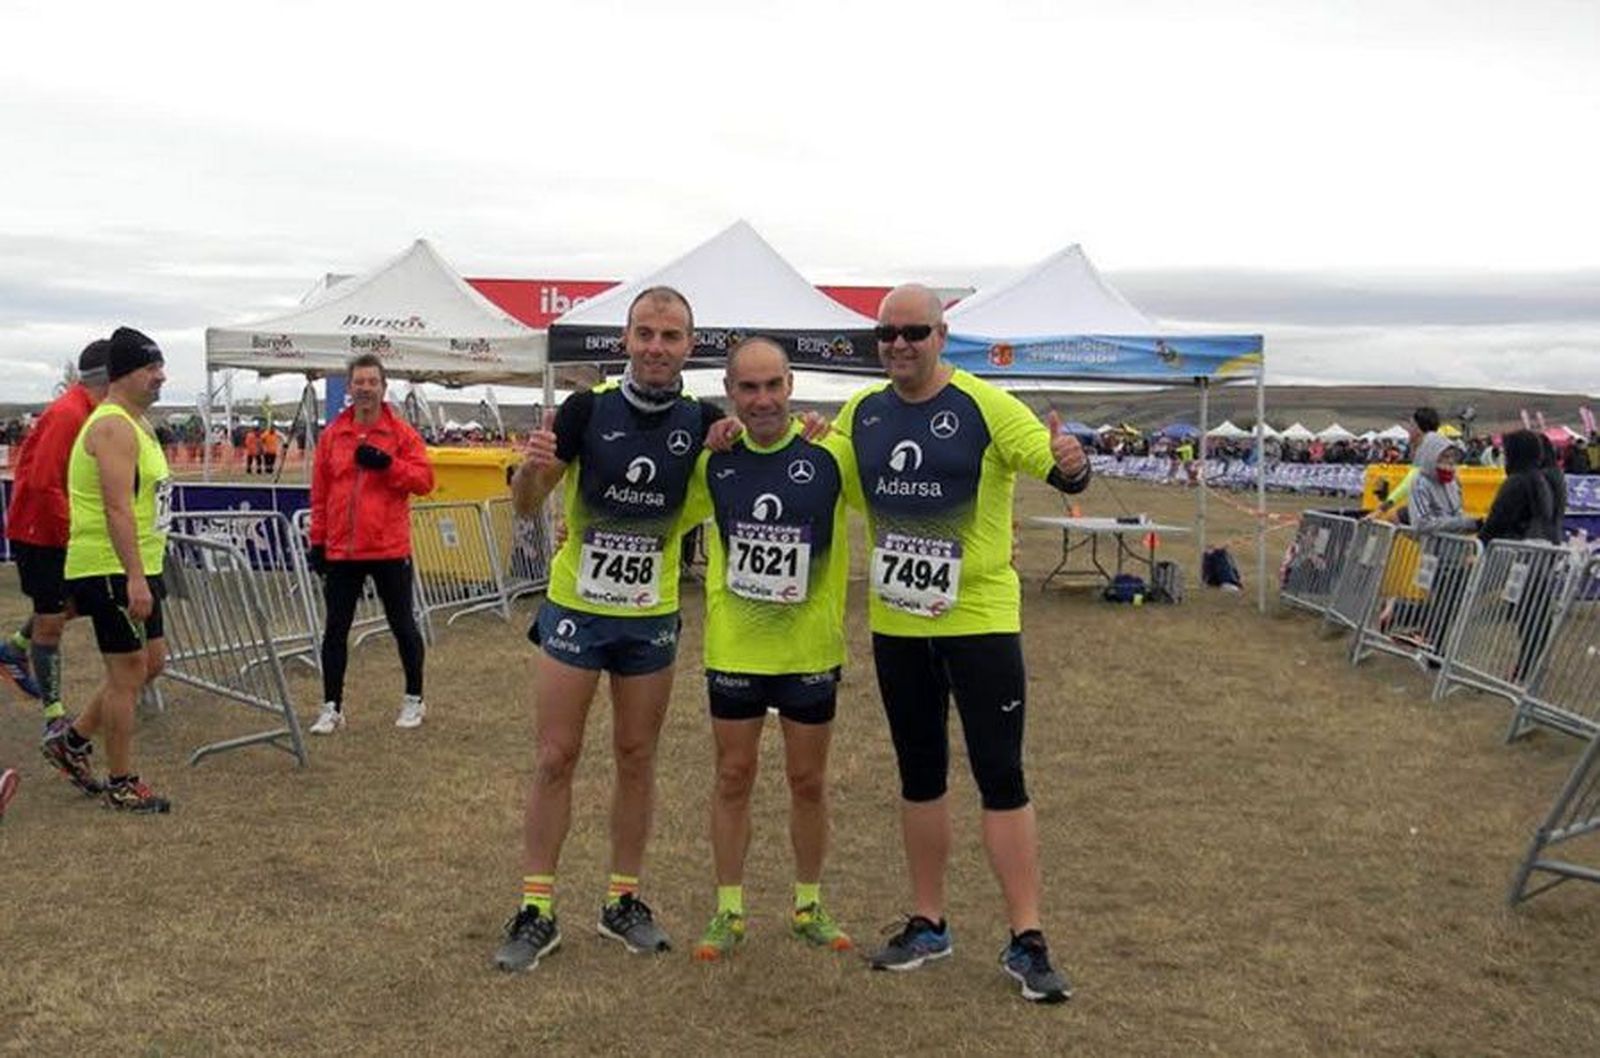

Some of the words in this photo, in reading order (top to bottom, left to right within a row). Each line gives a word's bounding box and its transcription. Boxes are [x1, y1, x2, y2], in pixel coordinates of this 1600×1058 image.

[343, 312, 427, 330] Burgos
[252, 335, 292, 350] Burgos
[351, 335, 391, 350] Burgos
[450, 338, 490, 353] Burgos
[797, 335, 853, 358] Burgos
[604, 484, 664, 506] Adarsa
[876, 477, 942, 497] Adarsa
[591, 551, 653, 584] 7458
[737, 542, 797, 577] 7621
[882, 554, 951, 592] 7494
